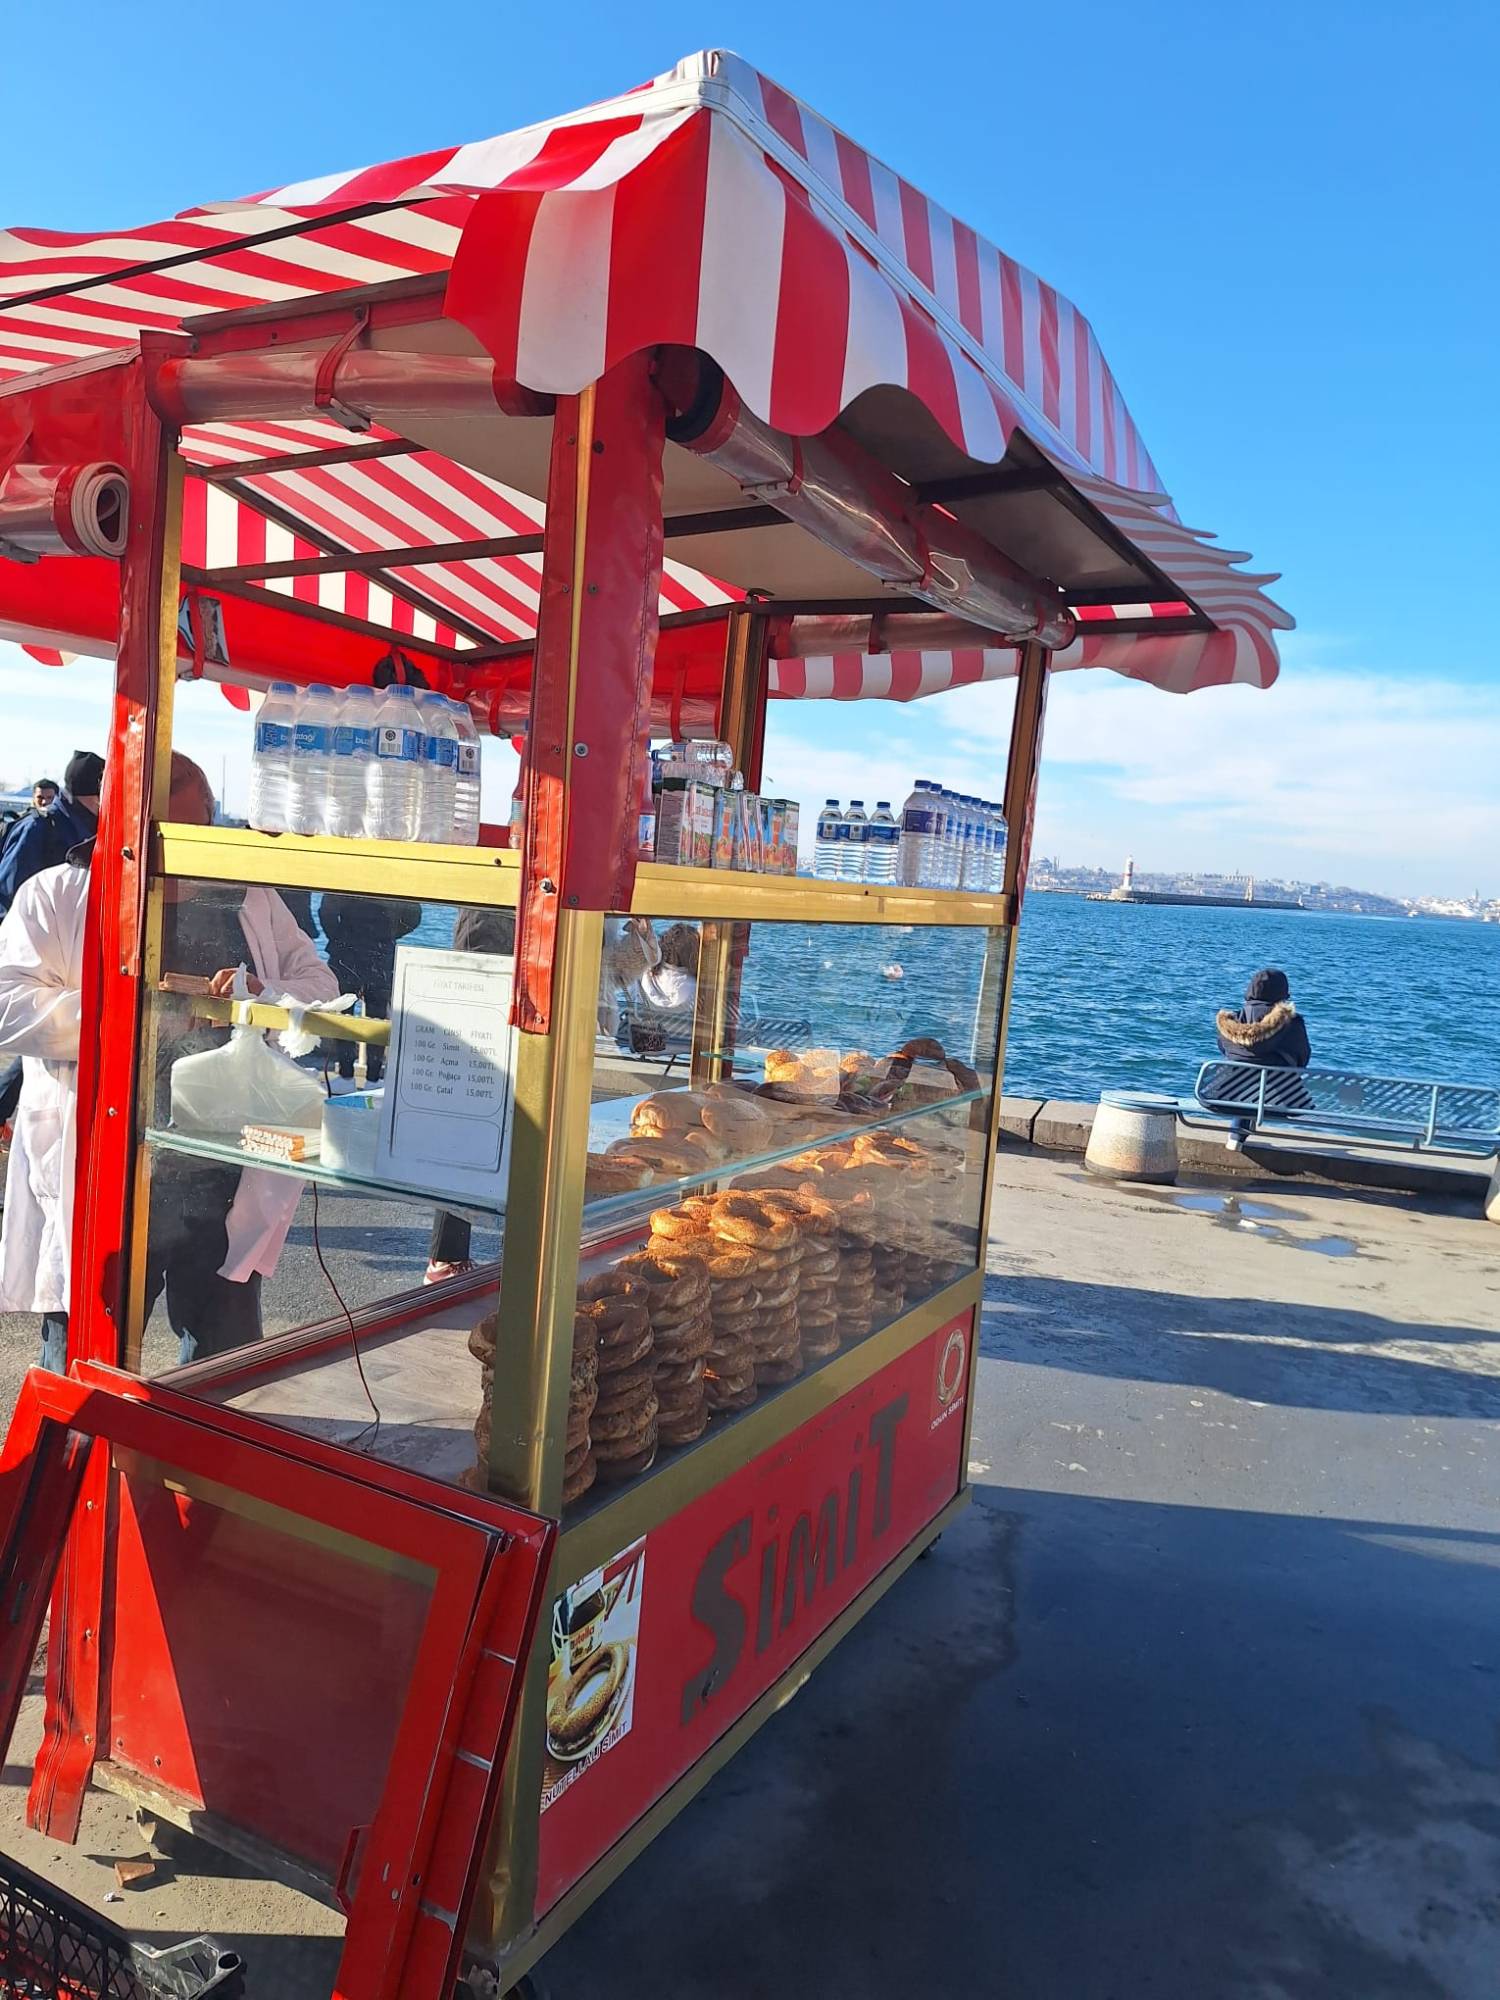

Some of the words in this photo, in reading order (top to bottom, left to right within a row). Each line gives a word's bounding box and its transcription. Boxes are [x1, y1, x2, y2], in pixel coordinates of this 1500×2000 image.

[415, 1040, 427, 1048] 100
[442, 1042, 460, 1052] Simit
[414, 1054, 425, 1062] 100
[412, 1068, 424, 1076] 100
[411, 1081, 423, 1090] 100
